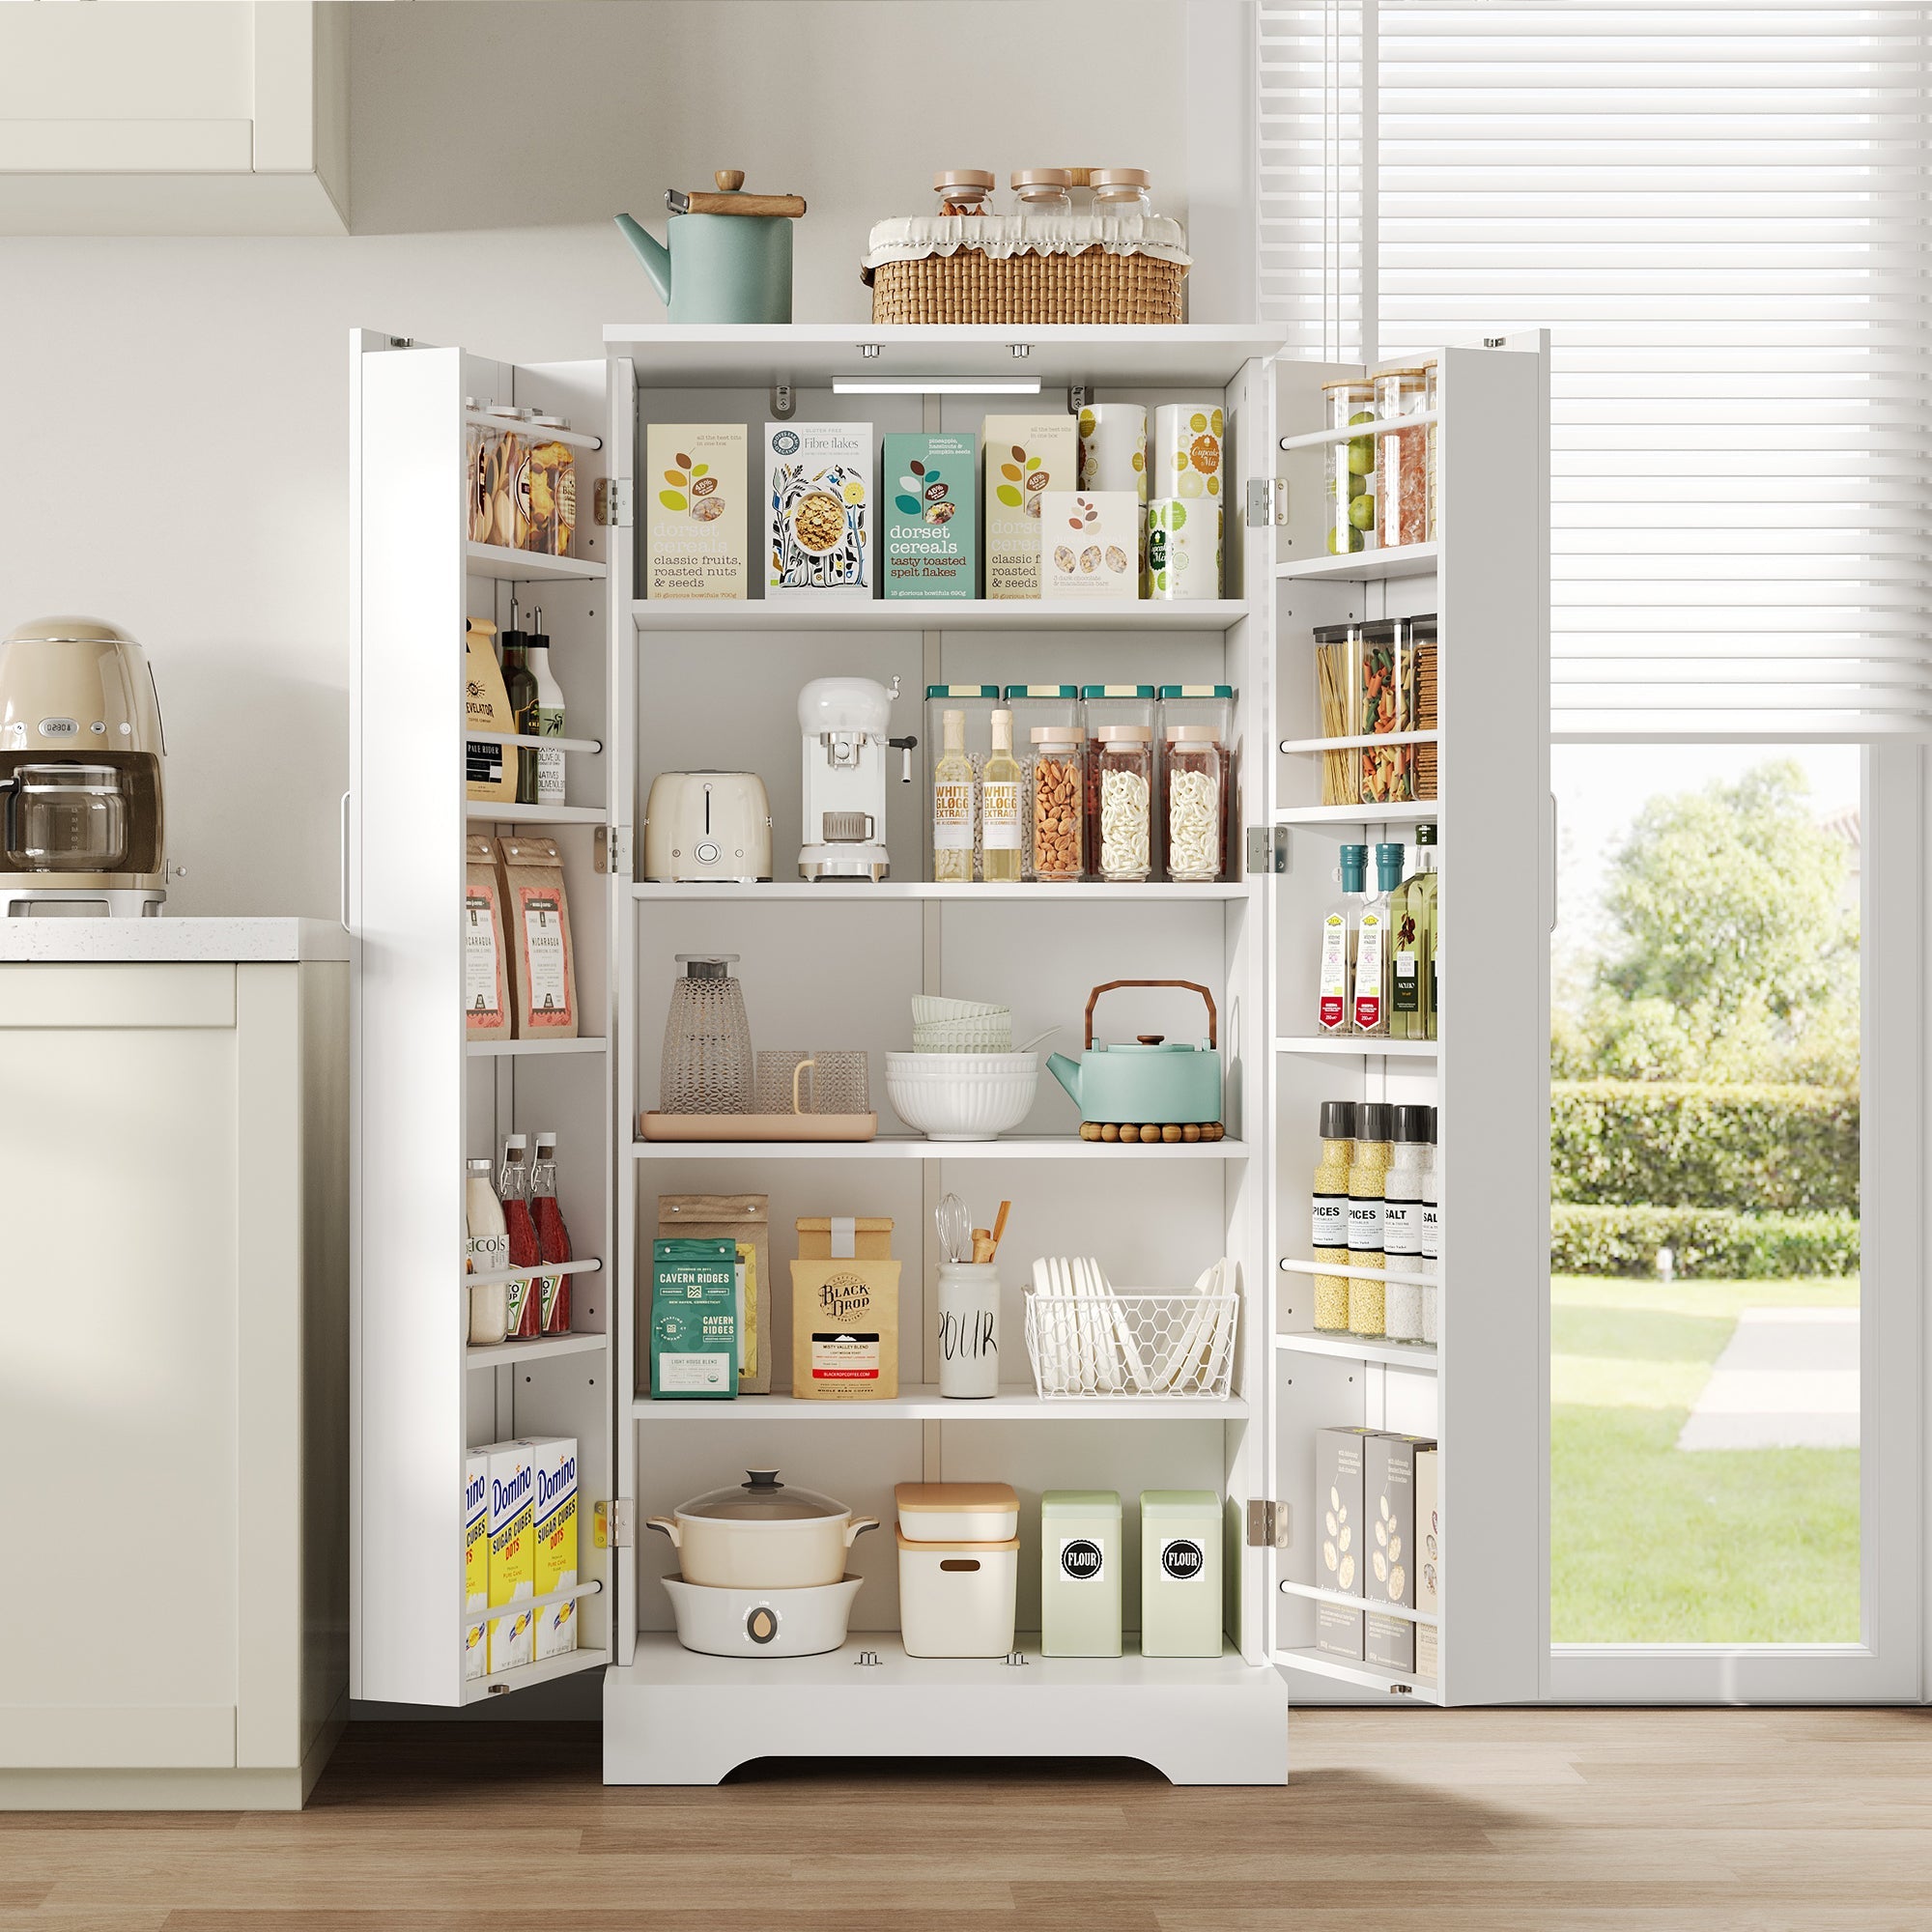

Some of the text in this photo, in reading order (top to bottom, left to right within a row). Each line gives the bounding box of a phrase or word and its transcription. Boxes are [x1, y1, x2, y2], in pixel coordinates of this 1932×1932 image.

[805, 437, 859, 449] Fibre flakes
[890, 525, 951, 539] dorset
[890, 540, 958, 554] cereals
[654, 555, 698, 566] classic
[891, 555, 967, 567] tasty toasted
[991, 554, 1033, 564] classic
[654, 567, 737, 577] roasted nuts
[891, 568, 956, 579] spelt flakes
[991, 566, 1037, 576] roasted
[654, 578, 705, 587] & seeds
[991, 578, 1038, 587] & seeds
[468, 744, 499, 754] PALE RIDER
[935, 785, 969, 798] WHITE
[983, 785, 1017, 798] WHITE
[936, 797, 969, 810] GLØGG
[984, 797, 1017, 810] GLØGG
[936, 810, 969, 818] EXTRACT
[984, 810, 1017, 818] EXTRACT
[1385, 1208, 1407, 1220] SALT
[660, 1273, 730, 1284] CAVERN RIDGES
[818, 1284, 869, 1306] BLACK
[826, 1296, 870, 1318] DROP
[702, 1316, 734, 1324] CAVERN
[702, 1325, 734, 1335] RIDGES
[536, 1456, 576, 1508] Domino
[492, 1465, 531, 1518] Domino
[537, 1498, 576, 1545] SUGAR CUBES
[467, 1518, 486, 1548] CUBES
[492, 1508, 532, 1555] SUGAR CUBES
[550, 1526, 565, 1550] DOTS
[505, 1537, 521, 1561] DOTS
[1067, 1551, 1097, 1567] FLOUR
[1168, 1551, 1198, 1567] FLOUR
